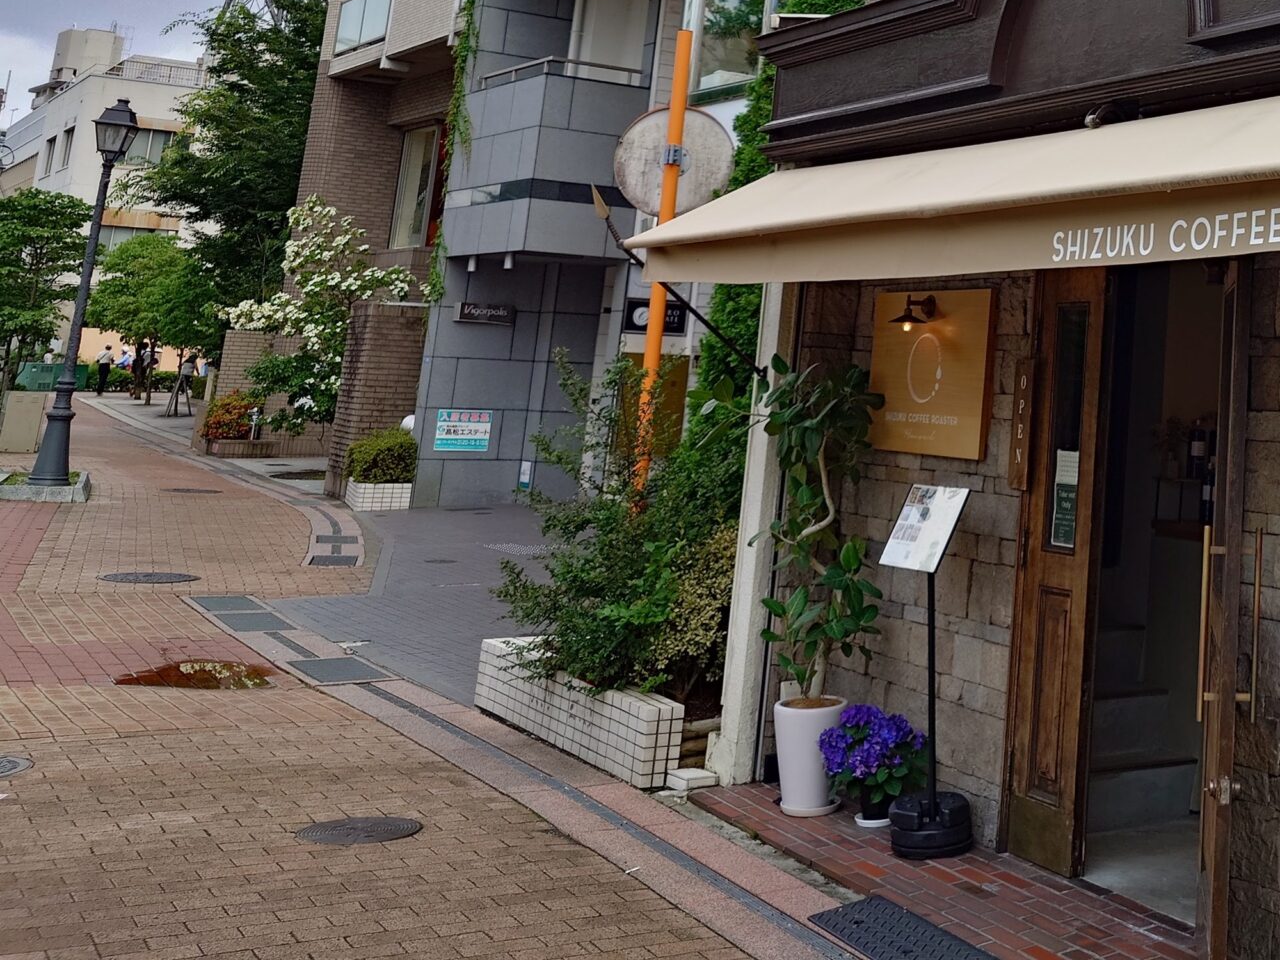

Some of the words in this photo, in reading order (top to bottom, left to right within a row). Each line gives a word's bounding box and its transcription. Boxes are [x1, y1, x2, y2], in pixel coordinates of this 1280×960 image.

[1052, 223, 1155, 262] SHIZUKU
[464, 304, 508, 317] Vigorpolis
[908, 413, 930, 424] COFFEE
[931, 414, 959, 426] ROASTER
[1015, 375, 1027, 464] OPEN
